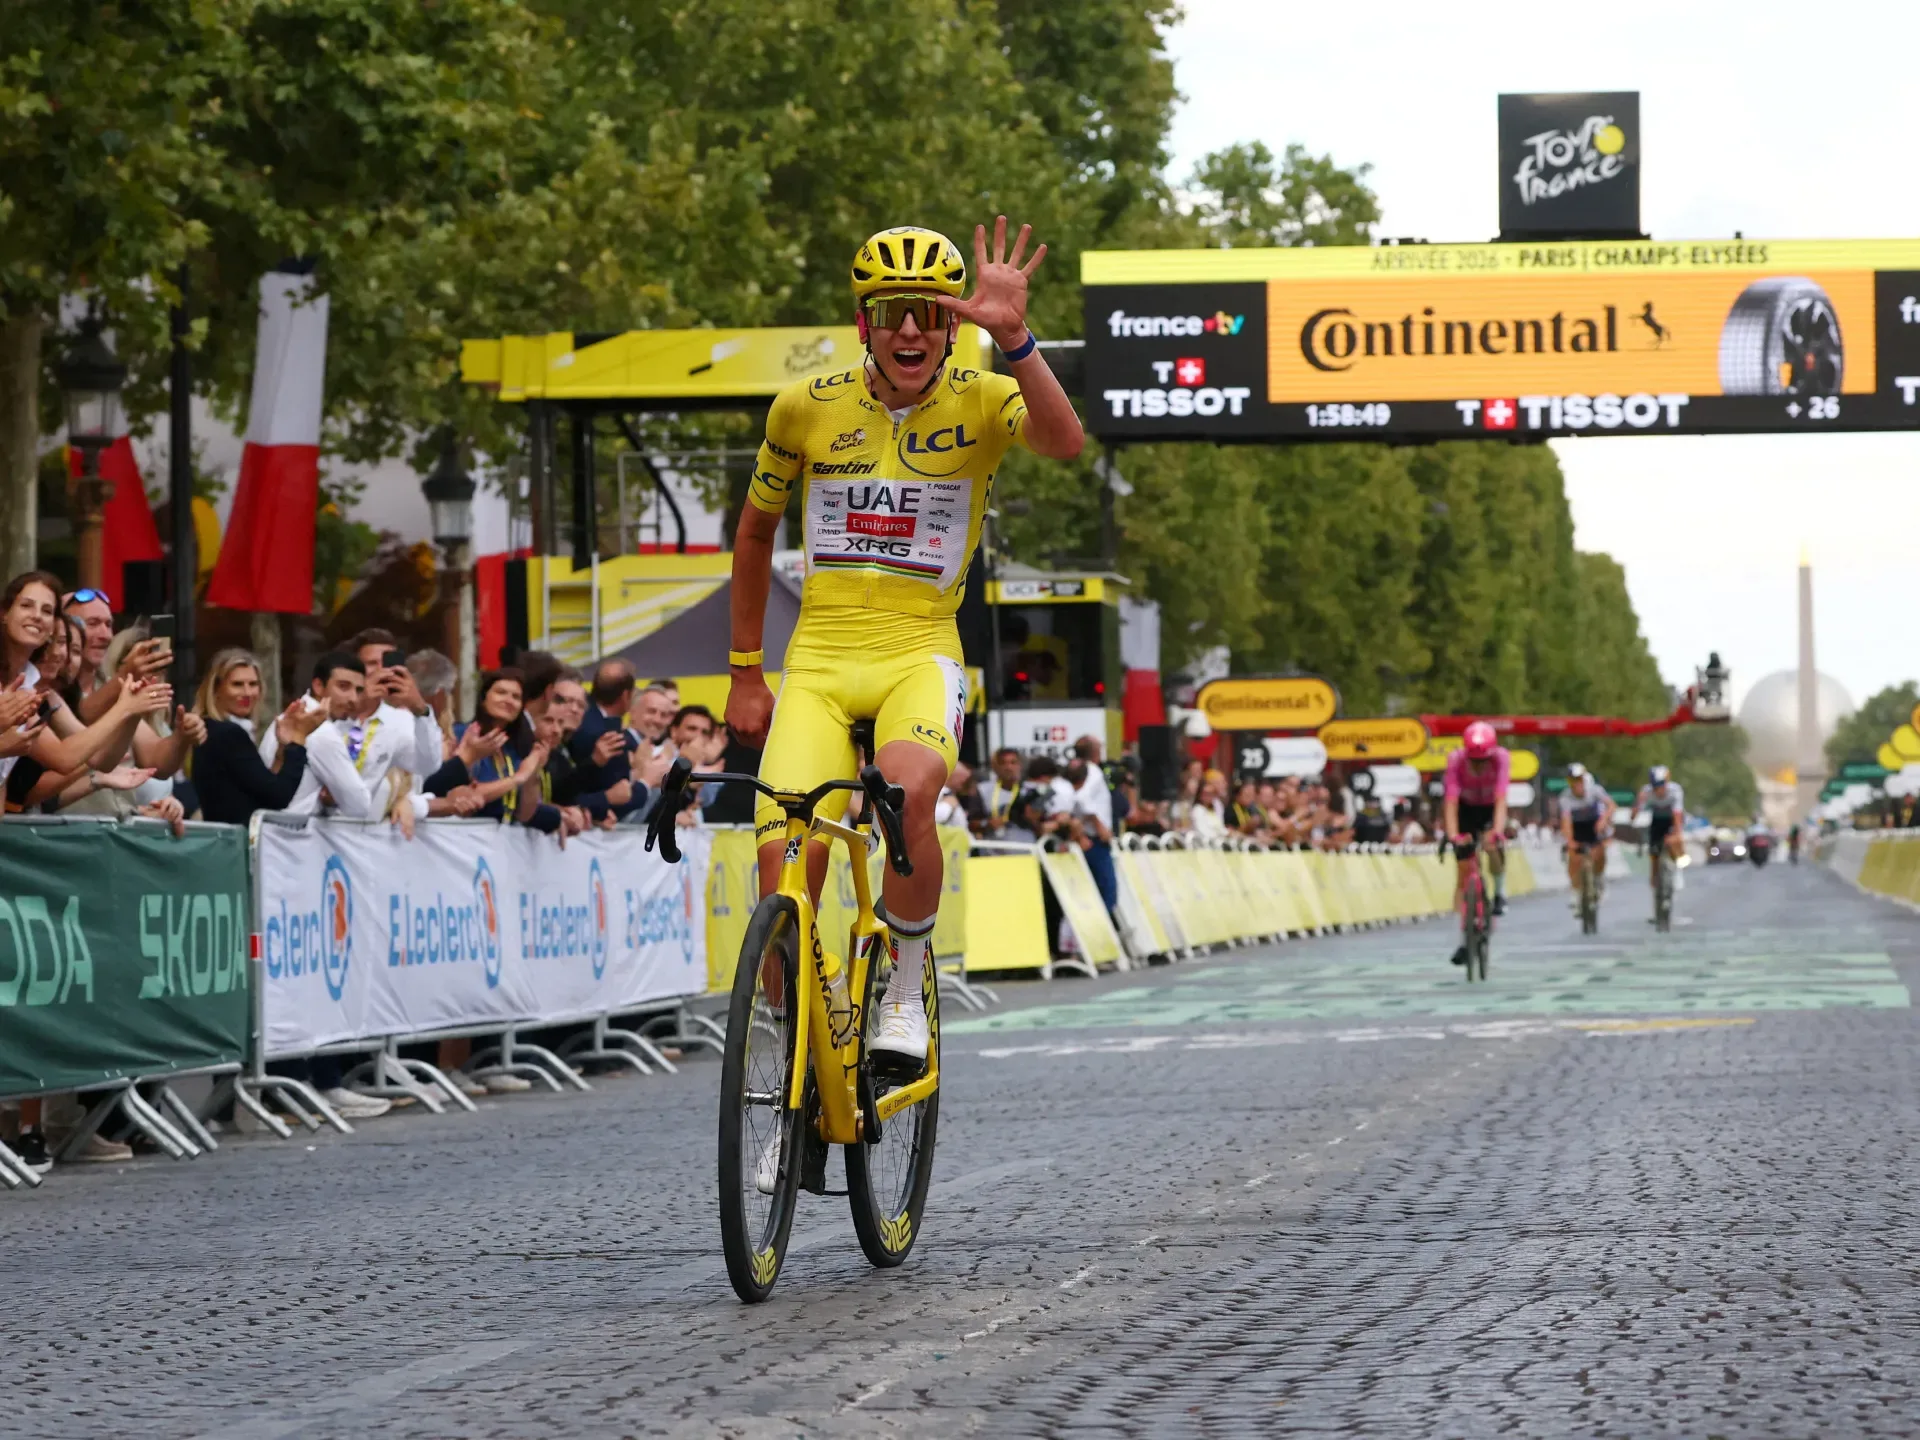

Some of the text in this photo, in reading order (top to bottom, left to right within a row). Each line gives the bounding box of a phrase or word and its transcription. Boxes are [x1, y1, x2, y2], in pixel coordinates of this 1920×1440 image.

[1519, 249, 1576, 267] PARIS
[1300, 305, 1618, 372] Continental
[814, 371, 856, 389] LCL
[1103, 387, 1250, 417] TISSOT
[1304, 402, 1392, 427] 1:58:49
[1518, 393, 1690, 429] TISSOT
[906, 423, 977, 453] LCL
[812, 461, 878, 475] Santini
[847, 486, 922, 513] UAE
[852, 519, 908, 532] Emirates
[844, 537, 911, 557] XRG
[756, 818, 788, 840] antini
[266, 897, 320, 980] clerc
[388, 892, 478, 968] E.Leclerc
[520, 891, 589, 959] E.Leclerc
[810, 921, 839, 1050] COLNAGO
